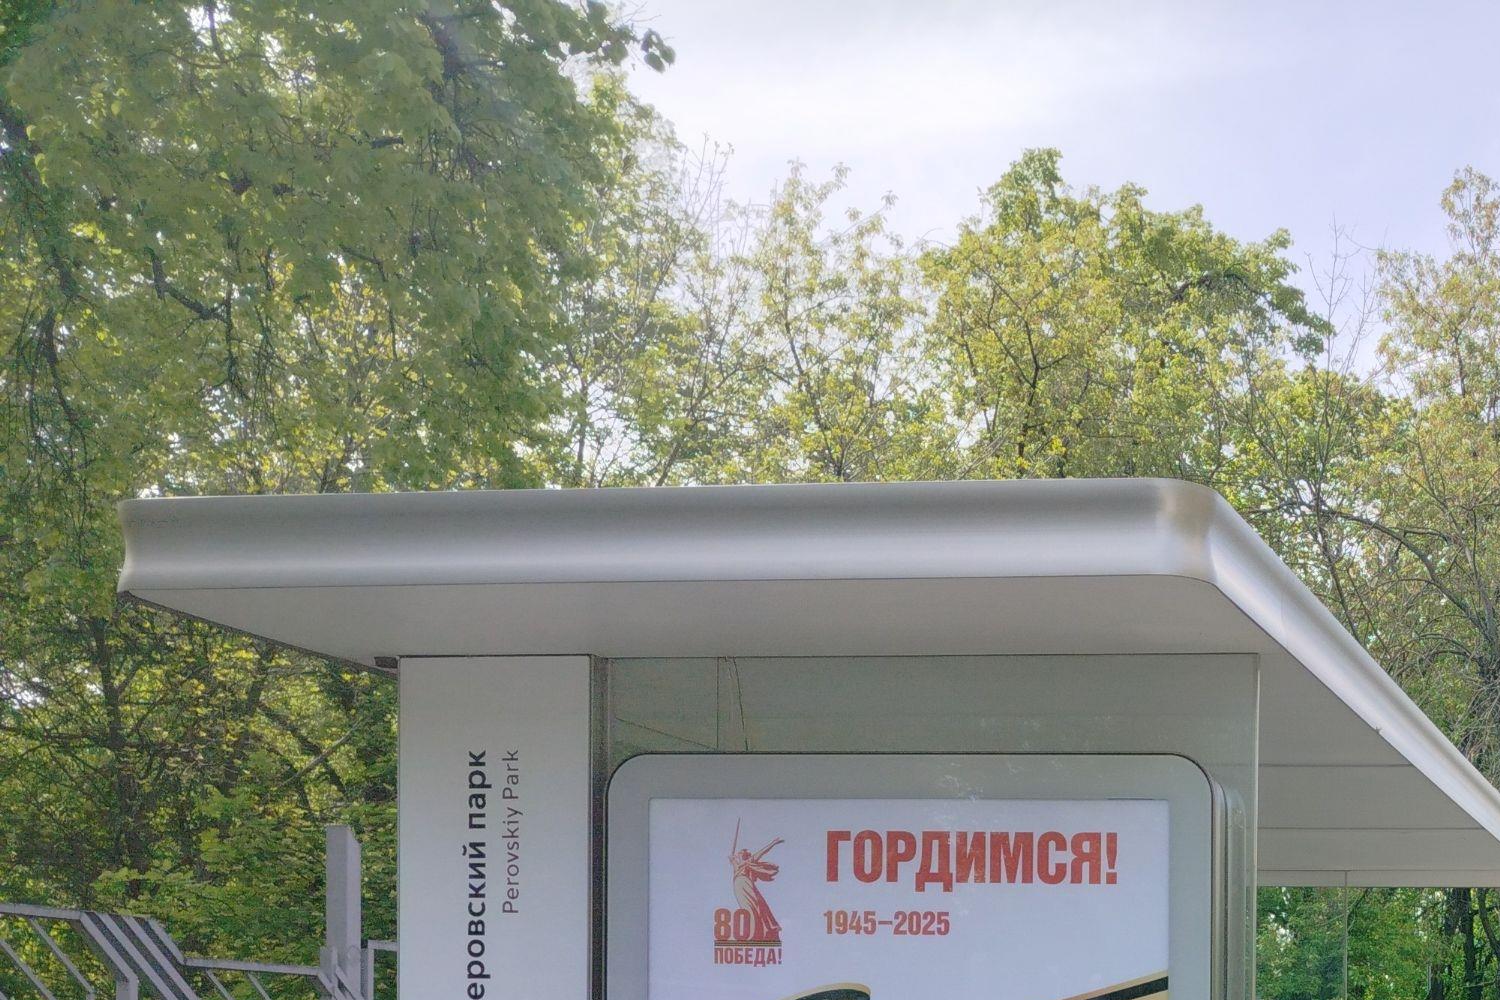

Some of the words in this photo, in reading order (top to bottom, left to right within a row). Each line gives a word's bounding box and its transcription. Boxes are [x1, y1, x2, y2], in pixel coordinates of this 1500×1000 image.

[467, 750, 492, 829] парк
[502, 750, 519, 800] Park
[502, 806, 523, 914] Perovskiy
[826, 830, 1118, 892] ГОРДИМСЯ!
[714, 908, 751, 941] 80
[714, 947, 782, 967] ПОБЕДА!
